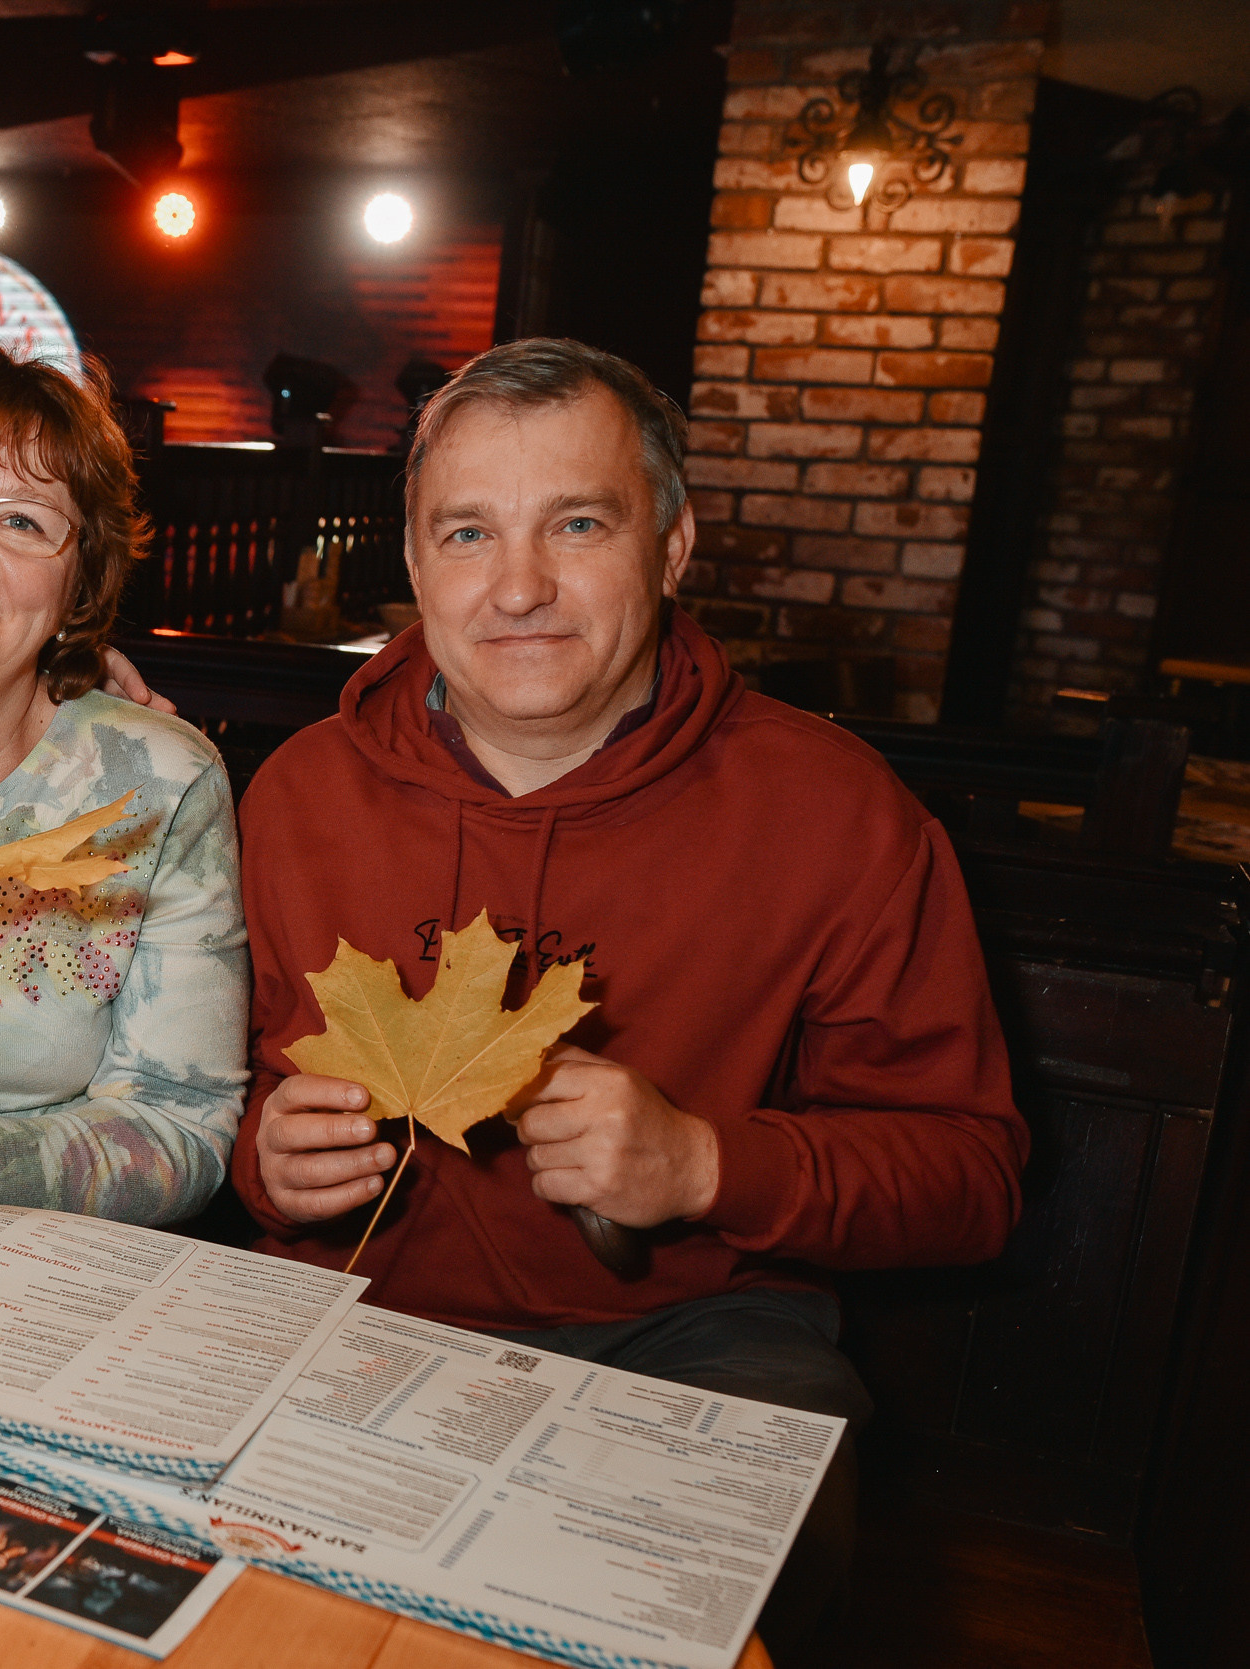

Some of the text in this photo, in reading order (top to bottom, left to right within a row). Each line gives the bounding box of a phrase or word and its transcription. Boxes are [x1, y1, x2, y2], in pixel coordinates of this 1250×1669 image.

[0, 1245, 81, 1271] ПРЕДЛОЖЕНИЕ
[176, 1486, 324, 1539] MAXIMILIAN'S
[322, 1532, 368, 1553] БАР
